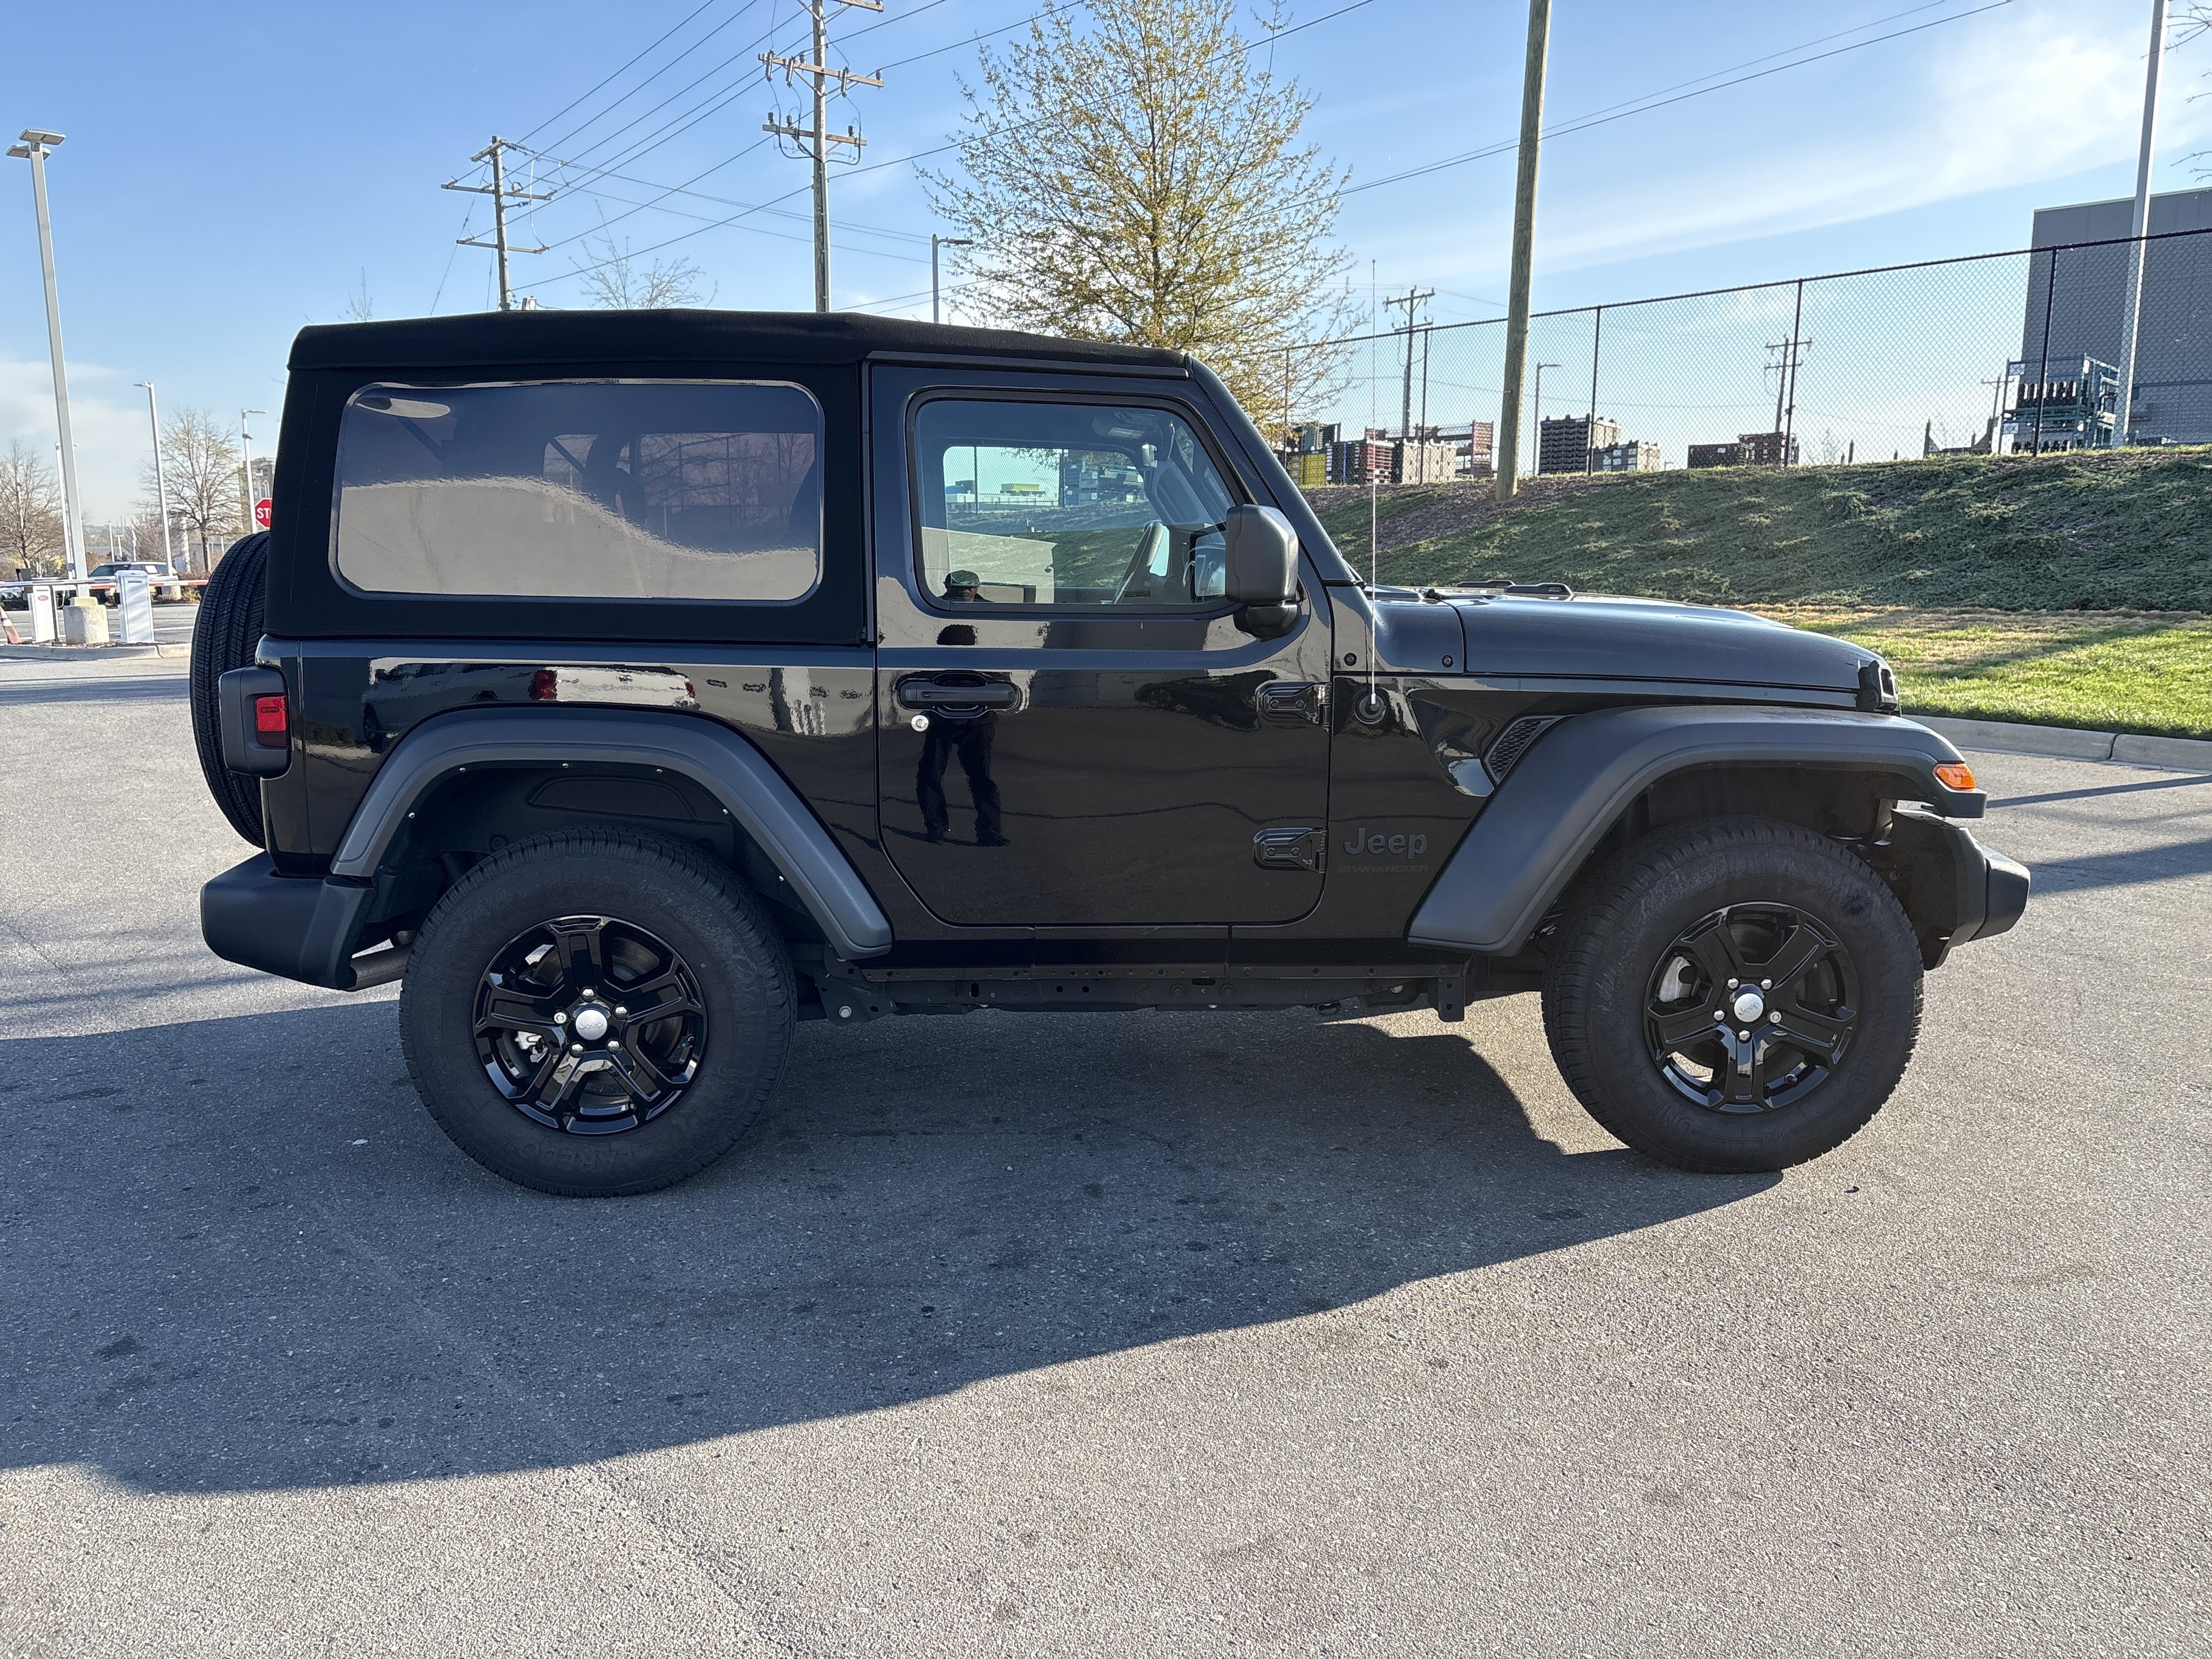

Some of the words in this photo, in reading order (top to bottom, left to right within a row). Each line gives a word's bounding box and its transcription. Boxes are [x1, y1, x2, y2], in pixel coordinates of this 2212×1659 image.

[257, 507, 271, 520] ST
[1344, 826, 1428, 860] Jeep
[1351, 865, 1430, 873] WRANGLER
[1738, 1001, 1760, 1015] Jeep
[579, 1020, 603, 1030] Jeep
